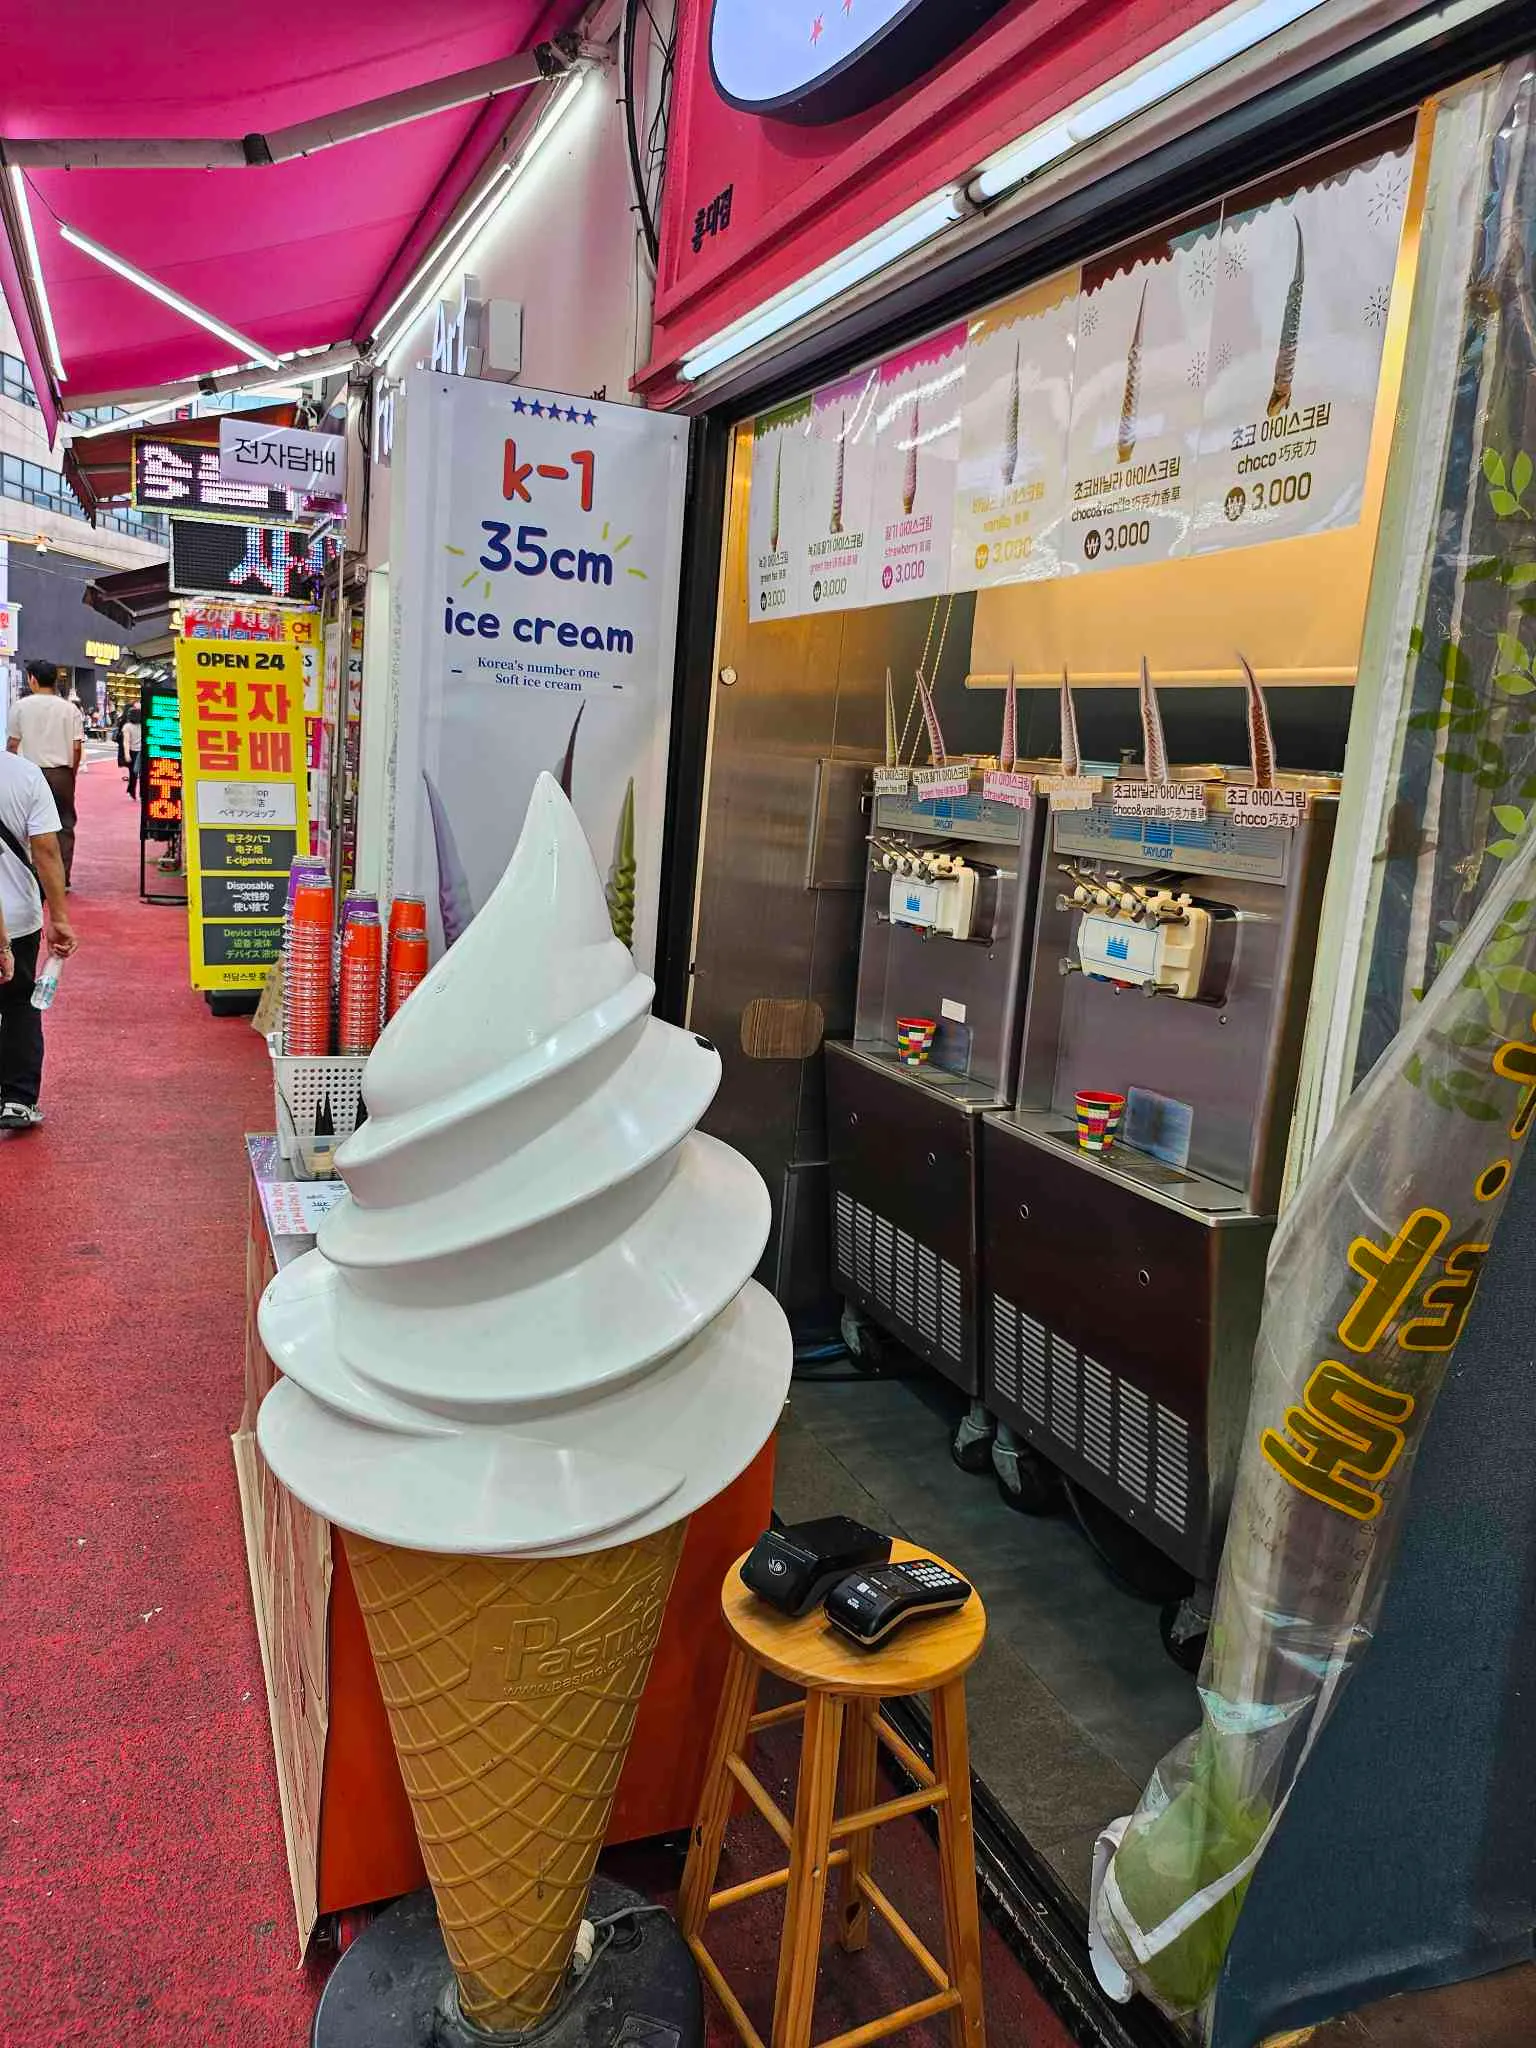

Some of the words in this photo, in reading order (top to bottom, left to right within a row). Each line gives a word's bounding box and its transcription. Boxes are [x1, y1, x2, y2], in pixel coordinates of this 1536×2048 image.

[1229, 422, 1258, 452] 초코
[1259, 401, 1332, 443] 아이스크림
[234, 437, 337, 476] 전자담배
[1236, 450, 1278, 475] choco
[1278, 438, 1318, 463] 巧克力
[1123, 455, 1182, 489] 아이스크림
[1250, 470, 1313, 513] 3,000
[1103, 520, 1151, 552] 3,000
[479, 519, 614, 586] 35cm
[895, 559, 926, 585] 3,000
[766, 588, 786, 607] 3,000
[822, 577, 848, 598] 3,000
[444, 597, 500, 639] ice
[512, 616, 634, 655] cream
[196, 652, 249, 669] OPEN
[254, 653, 286, 671] 24
[477, 656, 525, 672] Korea's
[526, 663, 577, 678] number
[578, 669, 601, 680] one
[495, 671, 521, 687] Soft
[522, 675, 542, 688] ice
[544, 679, 582, 692] cream
[1112, 783, 1159, 801] 초코바닐라
[1160, 785, 1205, 802] 아이스크림
[1226, 789, 1249, 807] 초코
[1251, 791, 1307, 809] 아이스크림
[1234, 811, 1268, 827] choco
[1268, 812, 1299, 828] 巧克力
[225, 855, 273, 867] E-cigarette
[1142, 845, 1174, 860] TAYLOR
[226, 880, 274, 891] Disposable
[253, 928, 281, 939] Liquid
